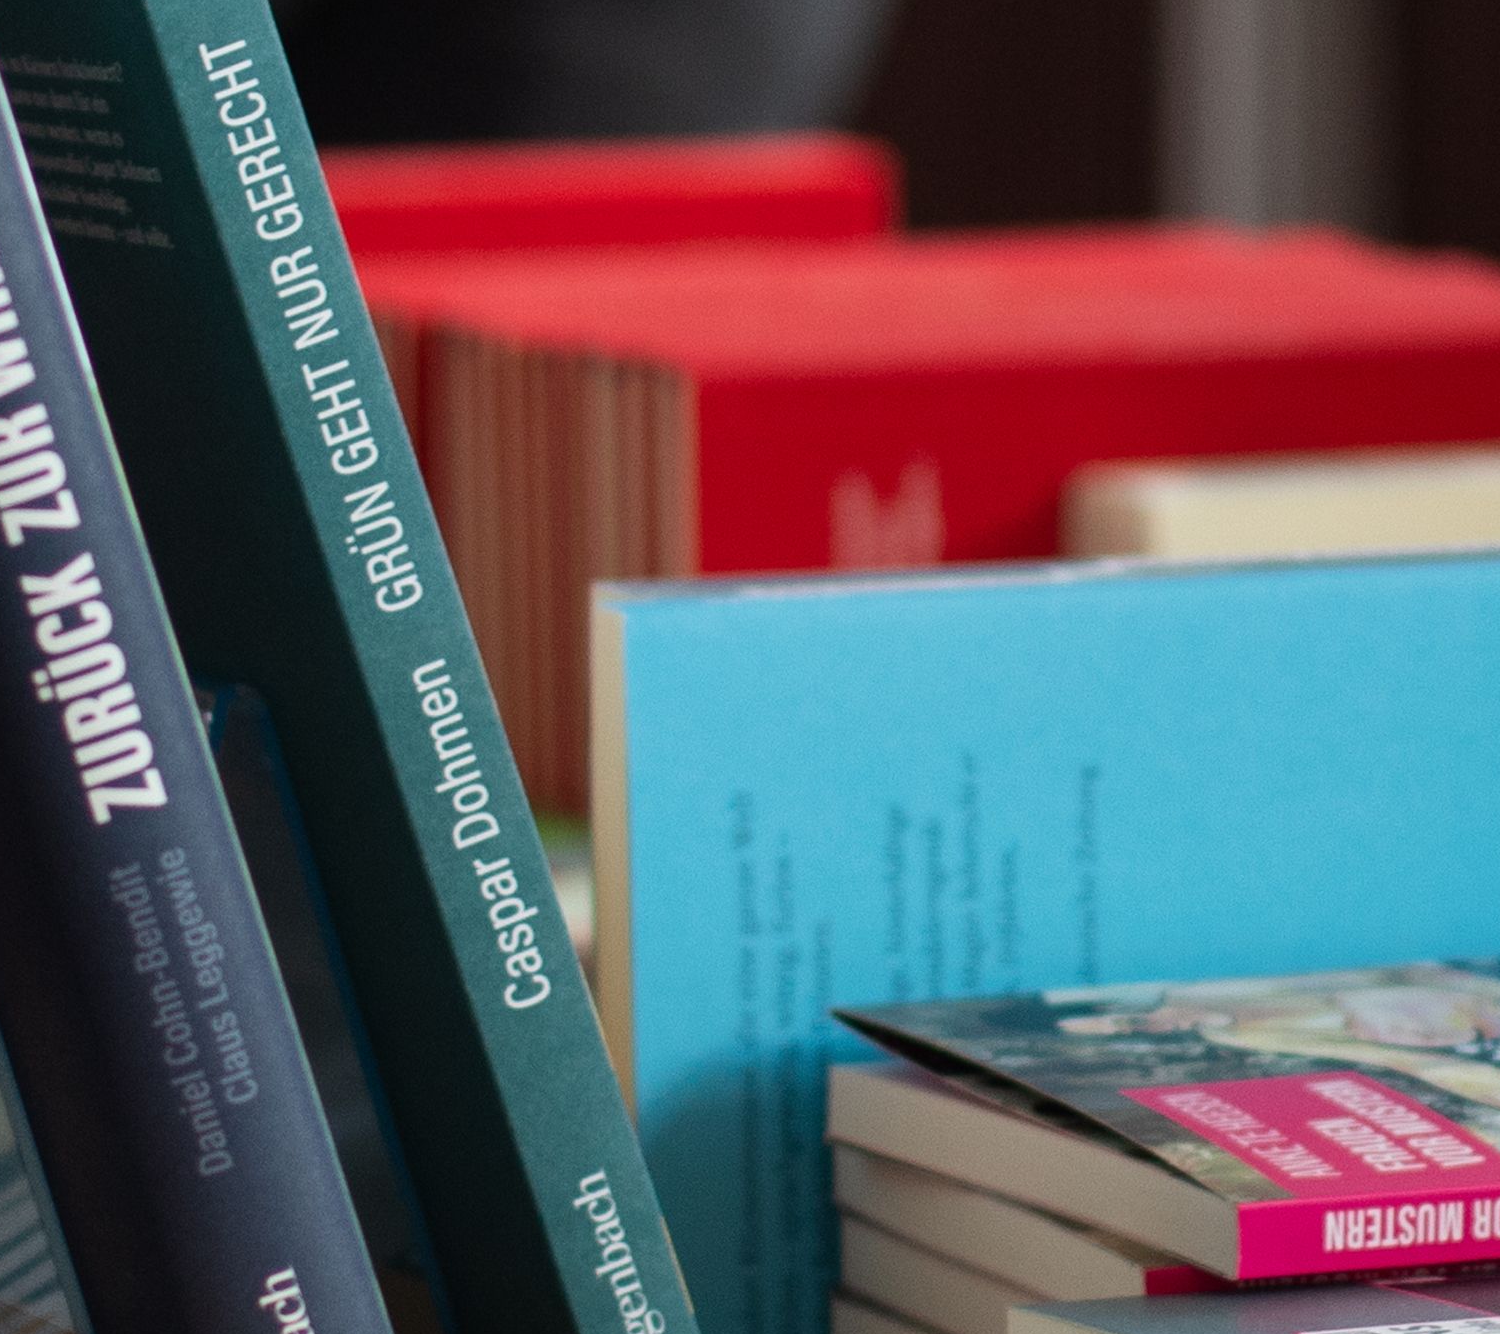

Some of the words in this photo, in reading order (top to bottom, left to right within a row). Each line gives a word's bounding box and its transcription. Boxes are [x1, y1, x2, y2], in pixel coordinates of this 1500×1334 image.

[199, 39, 304, 241] GERECHT
[270, 245, 340, 351] NUR
[302, 359, 379, 475] GEHT
[344, 481, 423, 612] GRÜN
[18, 551, 169, 825] ZURÜCK
[412, 658, 500, 850] Dohmen
[108, 862, 198, 1067] Cohn-Bendit
[156, 846, 230, 1010] Leggewie
[473, 857, 551, 1009] Caspar
[171, 1069, 233, 1177] Daniel
[211, 1010, 259, 1105] Claus
[1308, 1115, 1428, 1174] FRAUEN
[1323, 1201, 1465, 1252] MUSTERN
